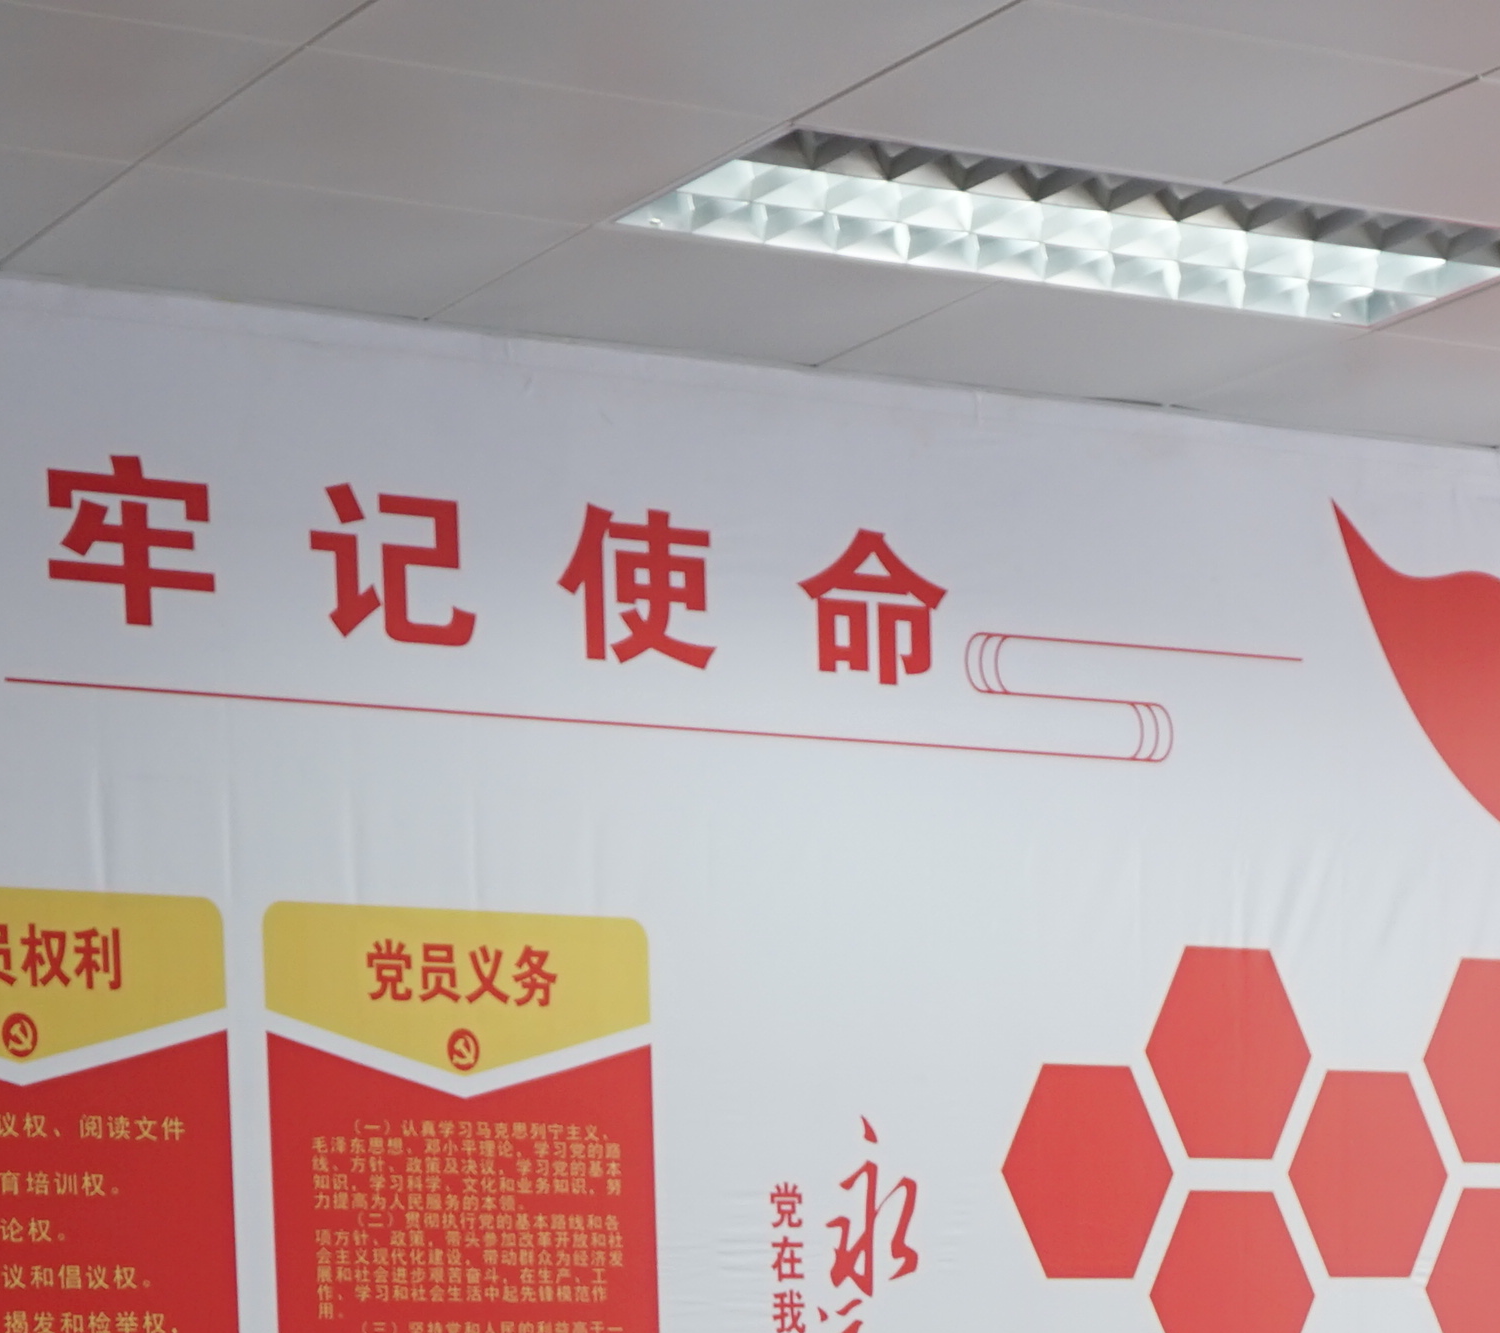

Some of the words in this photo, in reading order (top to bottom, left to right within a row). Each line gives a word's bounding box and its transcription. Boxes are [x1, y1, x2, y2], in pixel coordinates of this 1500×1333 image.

[46, 455, 947, 686] 牢记使命
[367, 941, 558, 1007] 党员义务
